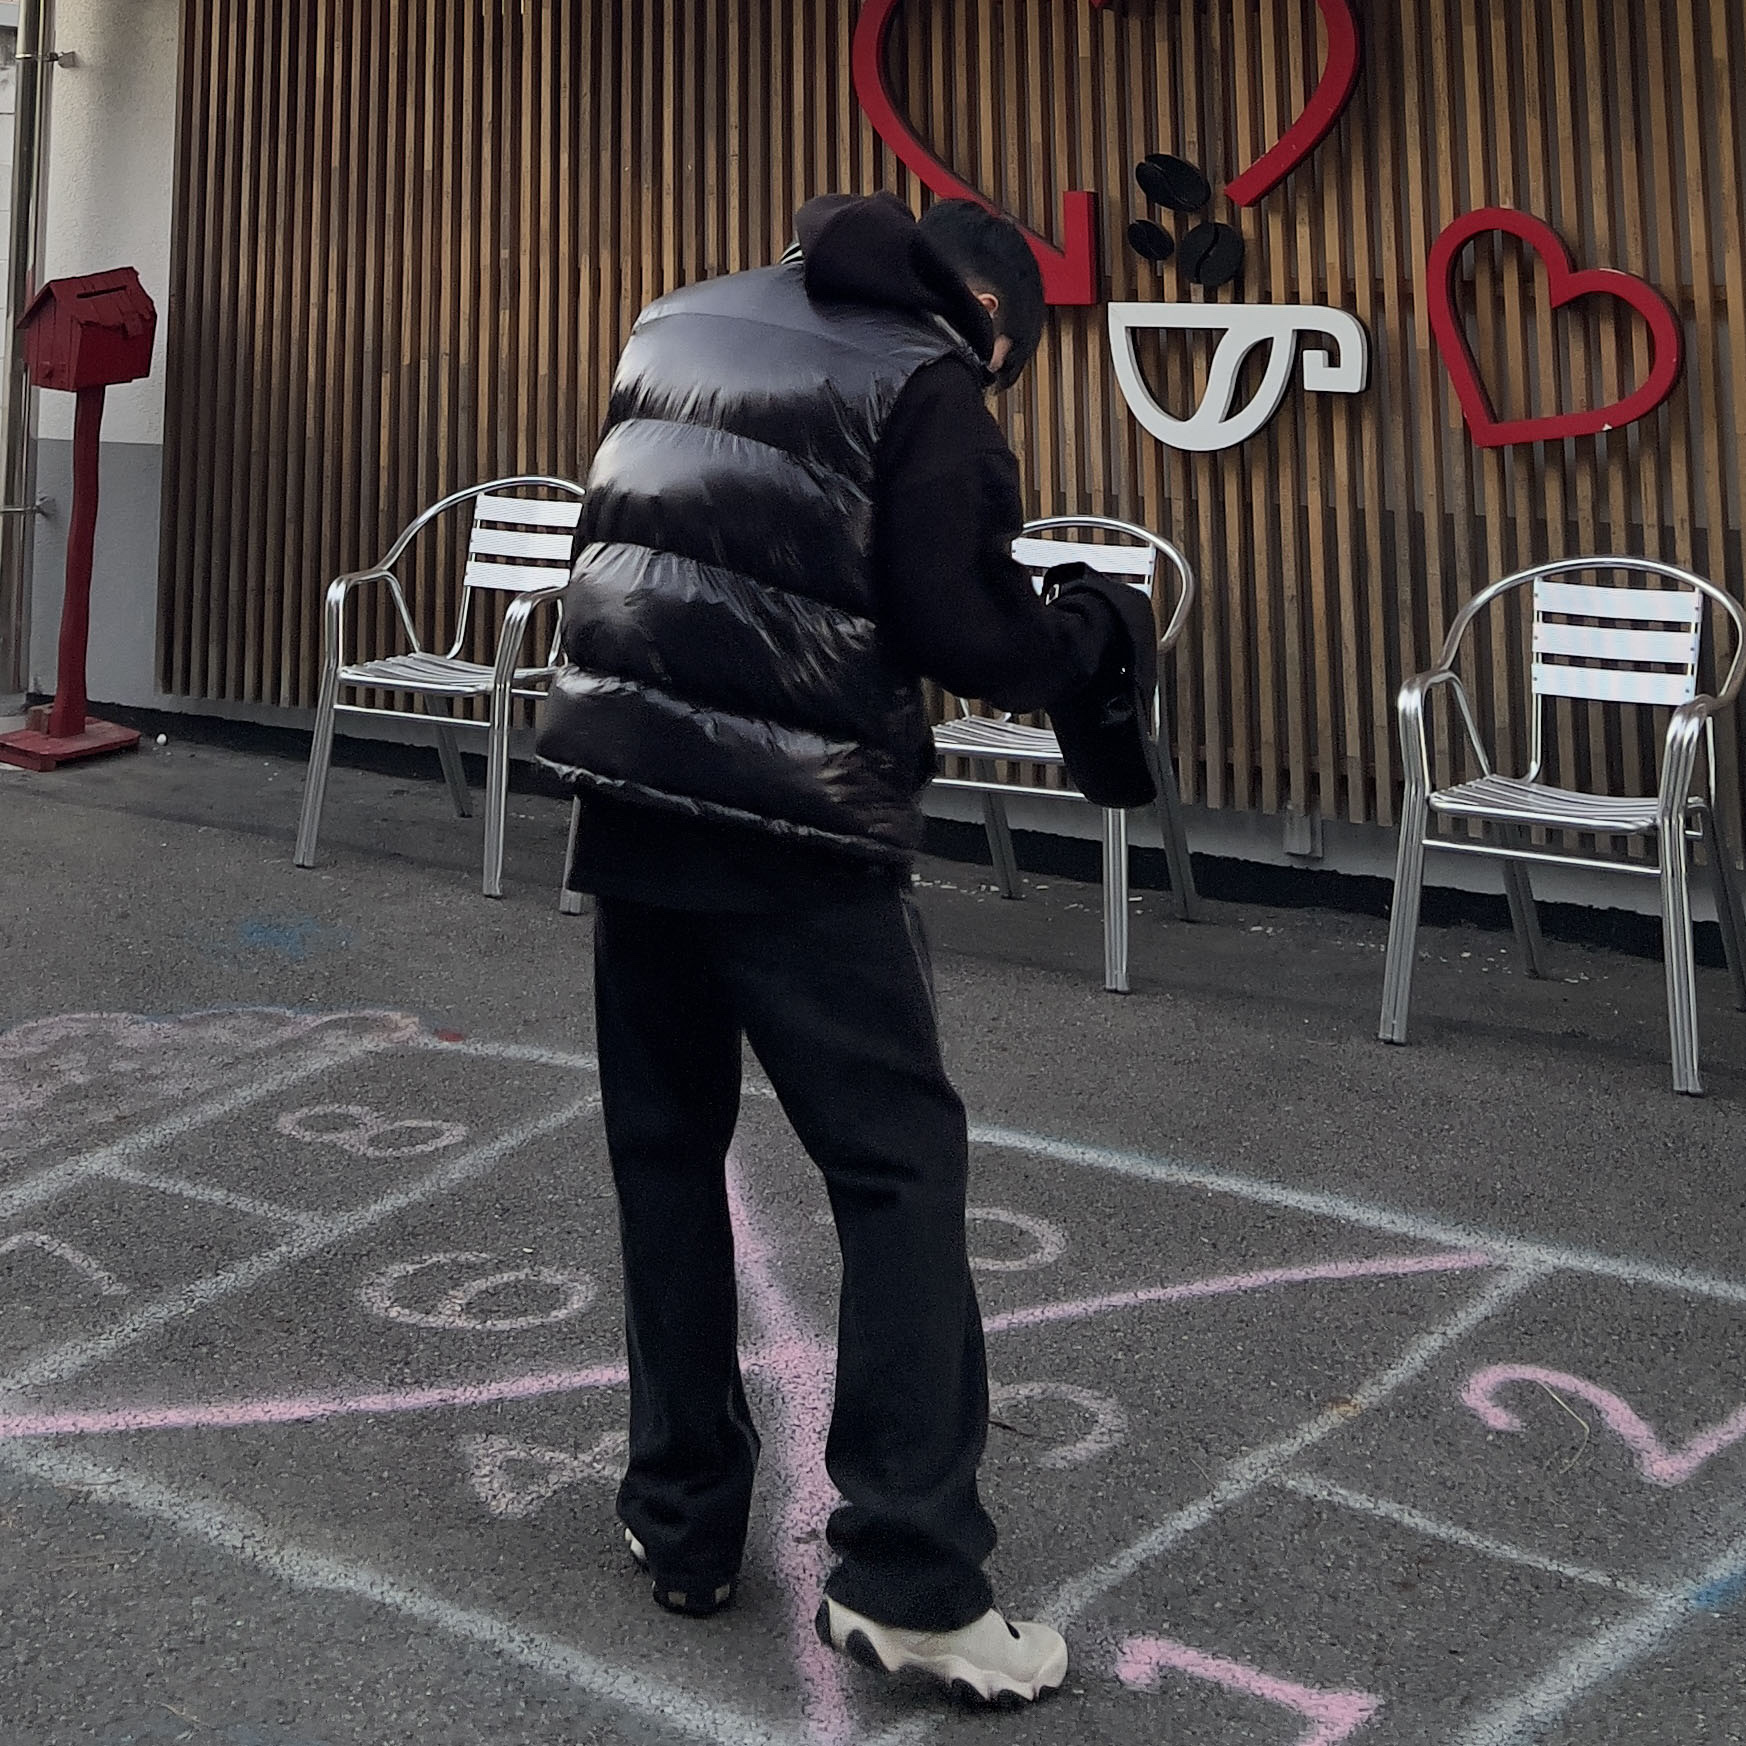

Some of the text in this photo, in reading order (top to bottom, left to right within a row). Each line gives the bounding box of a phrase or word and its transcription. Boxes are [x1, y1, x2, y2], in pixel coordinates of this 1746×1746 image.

[277, 1104, 468, 1157] 8
[361, 1252, 598, 1330] 6
[1460, 1364, 1746, 1485] 2
